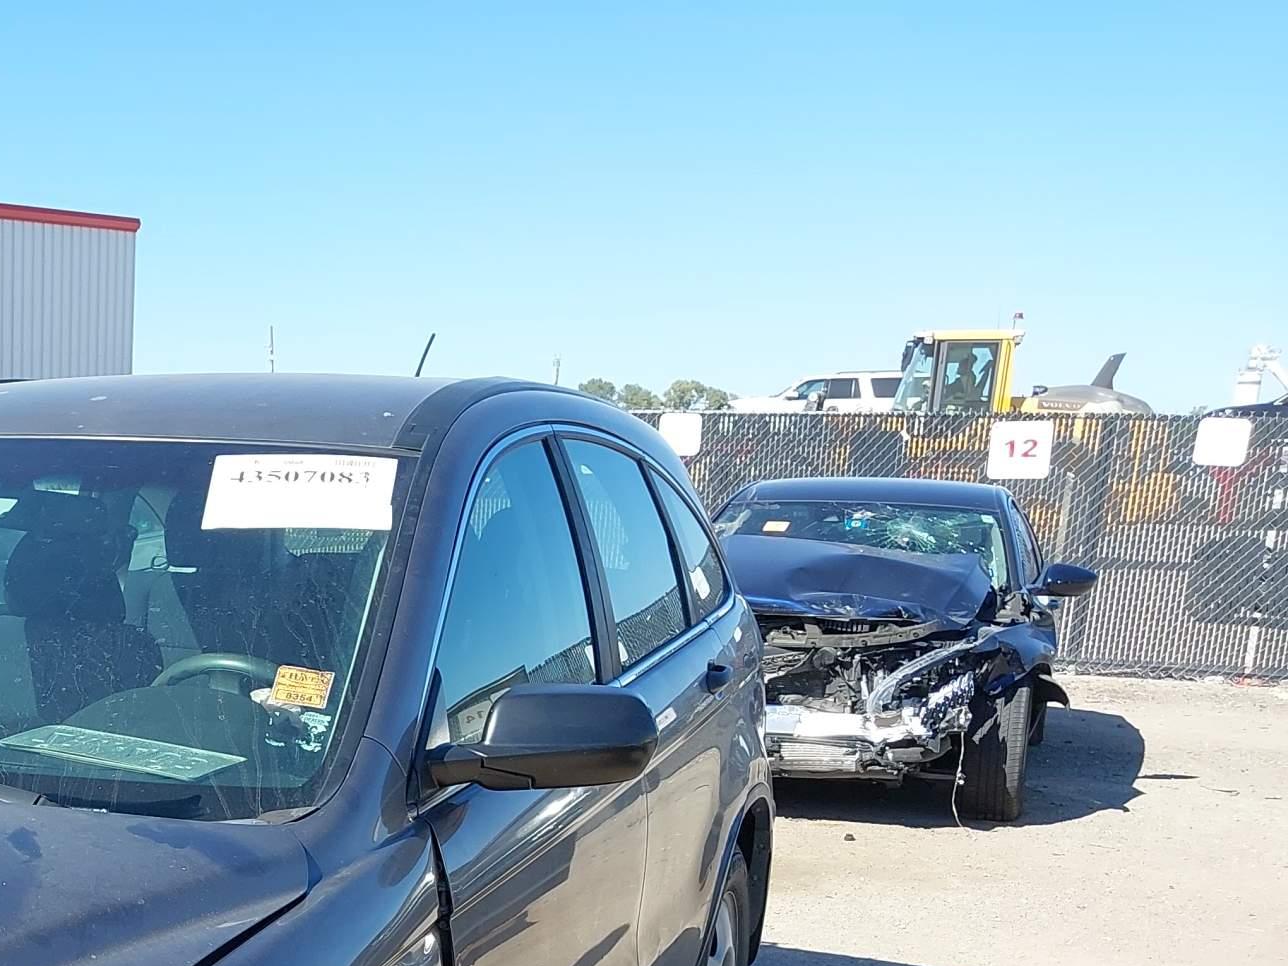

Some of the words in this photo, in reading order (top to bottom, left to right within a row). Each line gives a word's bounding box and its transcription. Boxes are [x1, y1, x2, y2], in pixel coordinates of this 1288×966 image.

[1041, 401, 1081, 410] VOLVO
[1004, 439, 1039, 458] 12
[230, 469, 372, 486] 43507083
